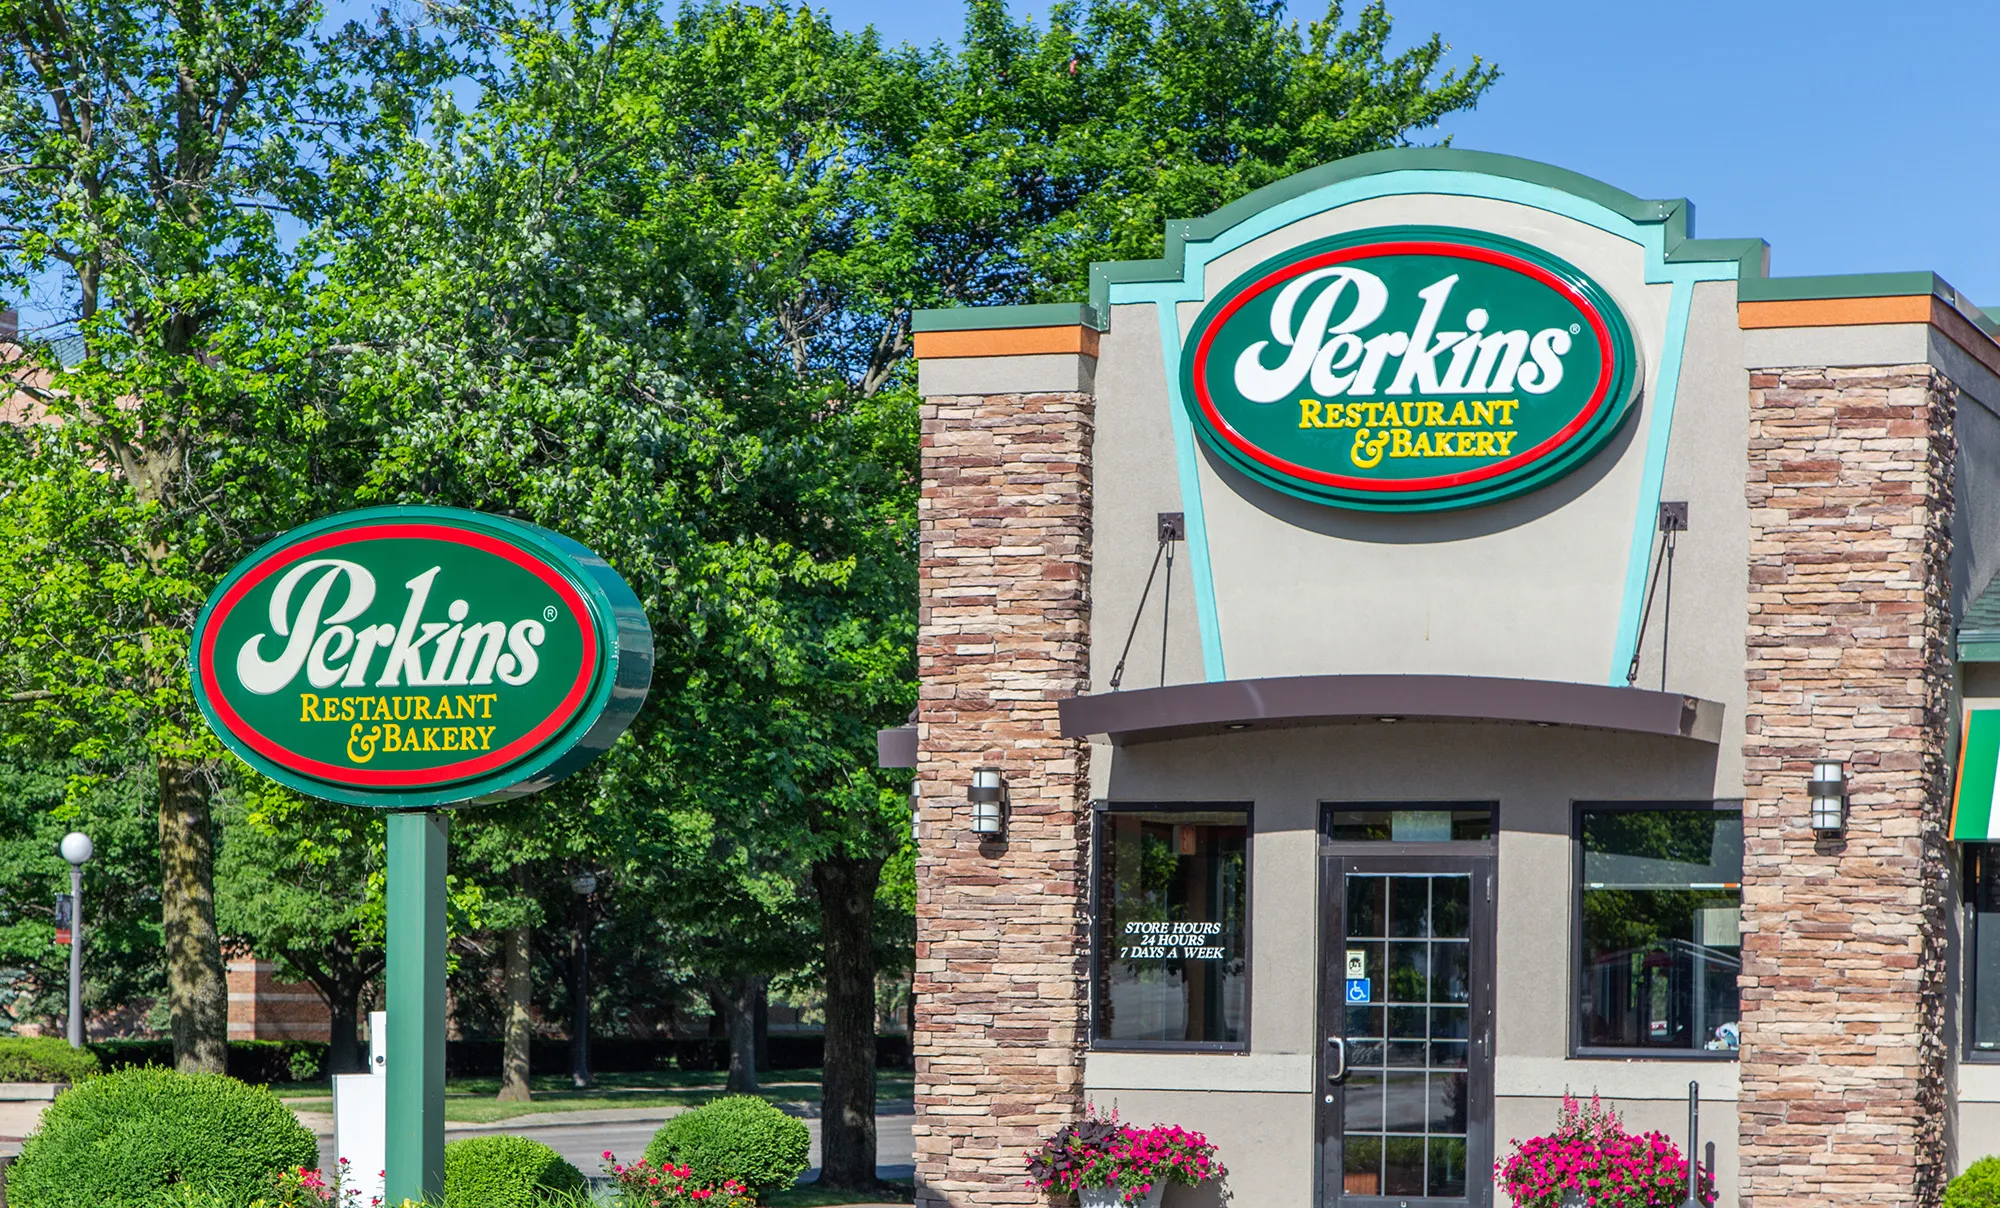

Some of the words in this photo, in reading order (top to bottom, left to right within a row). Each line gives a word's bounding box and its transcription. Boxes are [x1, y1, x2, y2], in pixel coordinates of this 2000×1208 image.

[1234, 266, 1571, 403] Perkins
[1298, 399, 1519, 428] RESTAURANT
[236, 558, 545, 695] Perkins
[299, 693, 497, 722] RESTAURANT
[1124, 922, 1169, 934] STORE
[1173, 922, 1221, 934] HOURS
[1140, 934, 1156, 946] 24
[1158, 934, 1205, 946] HOURS
[1120, 946, 1129, 958] 7
[1130, 946, 1164, 958] DAYS
[1166, 947, 1178, 958] A
[1184, 947, 1225, 959] WEEK
